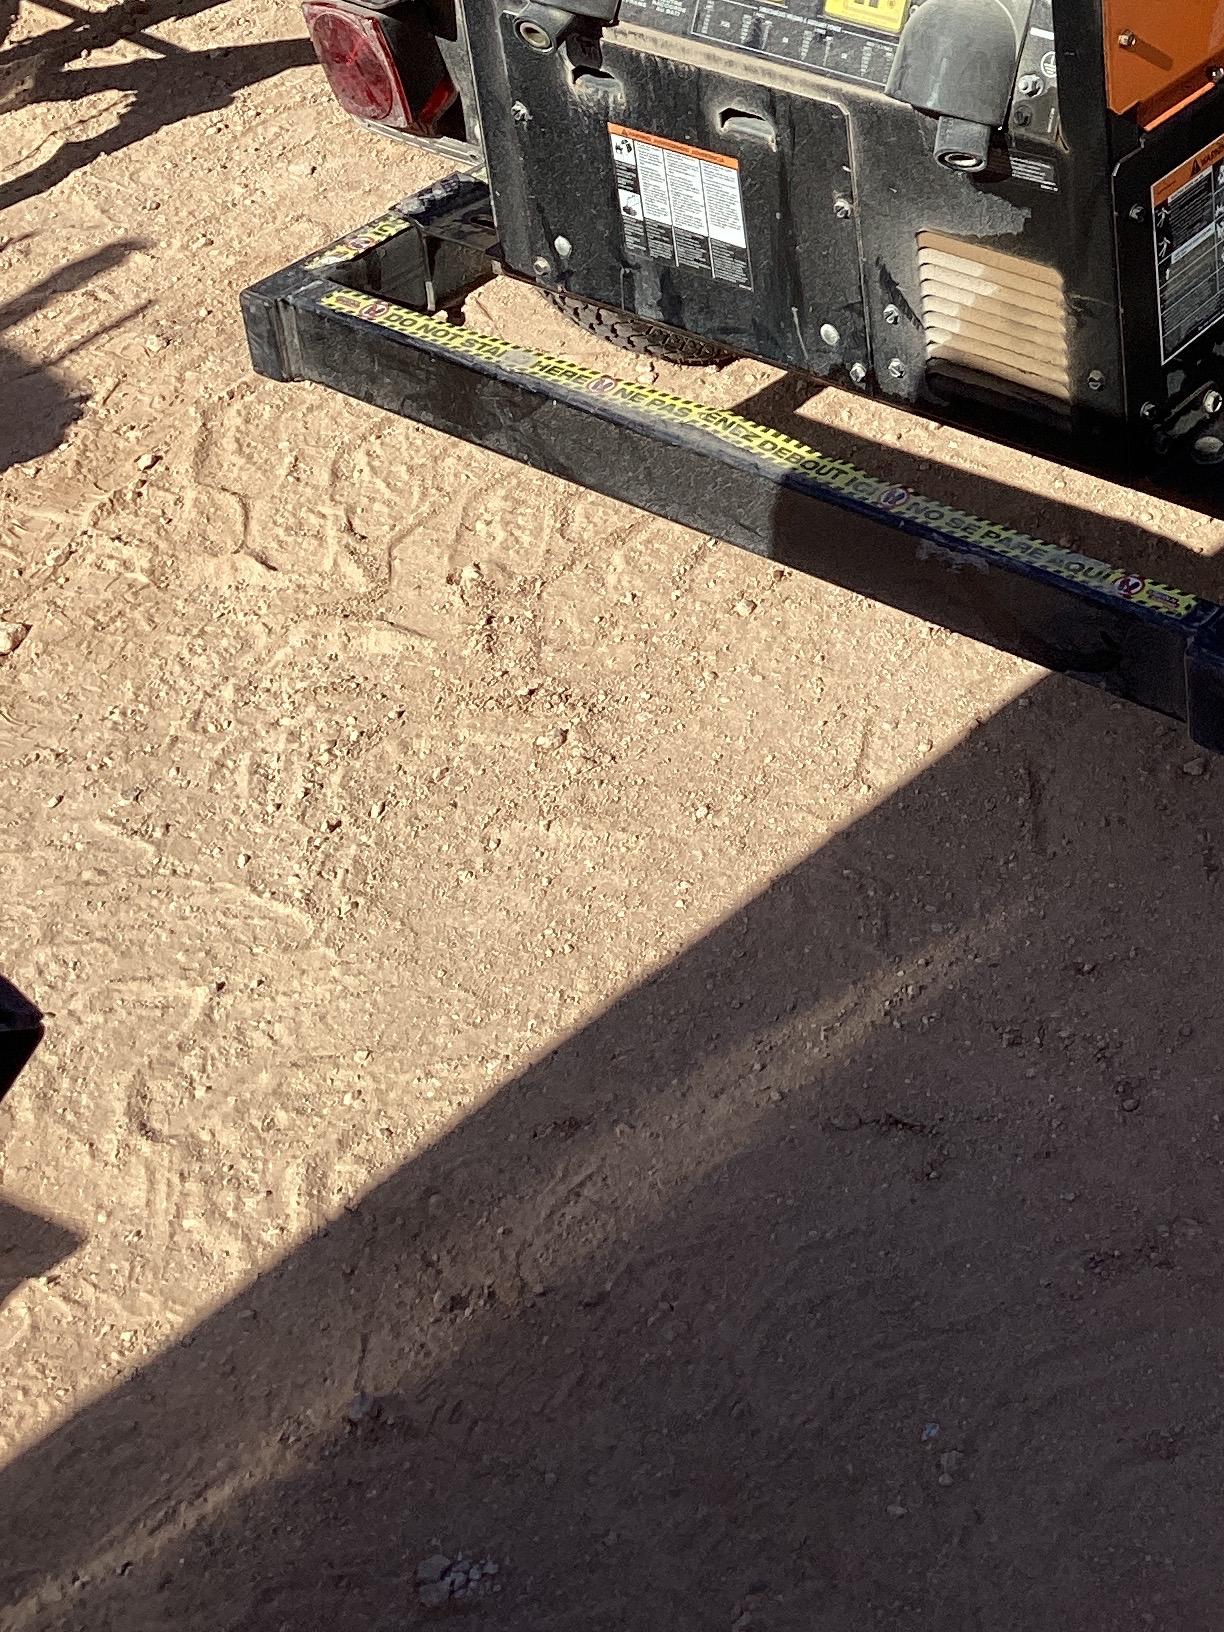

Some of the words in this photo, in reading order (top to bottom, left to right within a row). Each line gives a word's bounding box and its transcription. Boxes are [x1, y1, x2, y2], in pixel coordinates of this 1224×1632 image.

[387, 312, 414, 328] DO
[416, 322, 464, 342] NOT
[464, 338, 510, 359] STA
[530, 360, 592, 386] HERE
[612, 386, 642, 403] NE
[651, 398, 692, 418] PAS
[758, 440, 850, 477] DEBOUT
[849, 474, 881, 496] ICI
[906, 502, 944, 520] NO
[946, 516, 982, 537] SE
